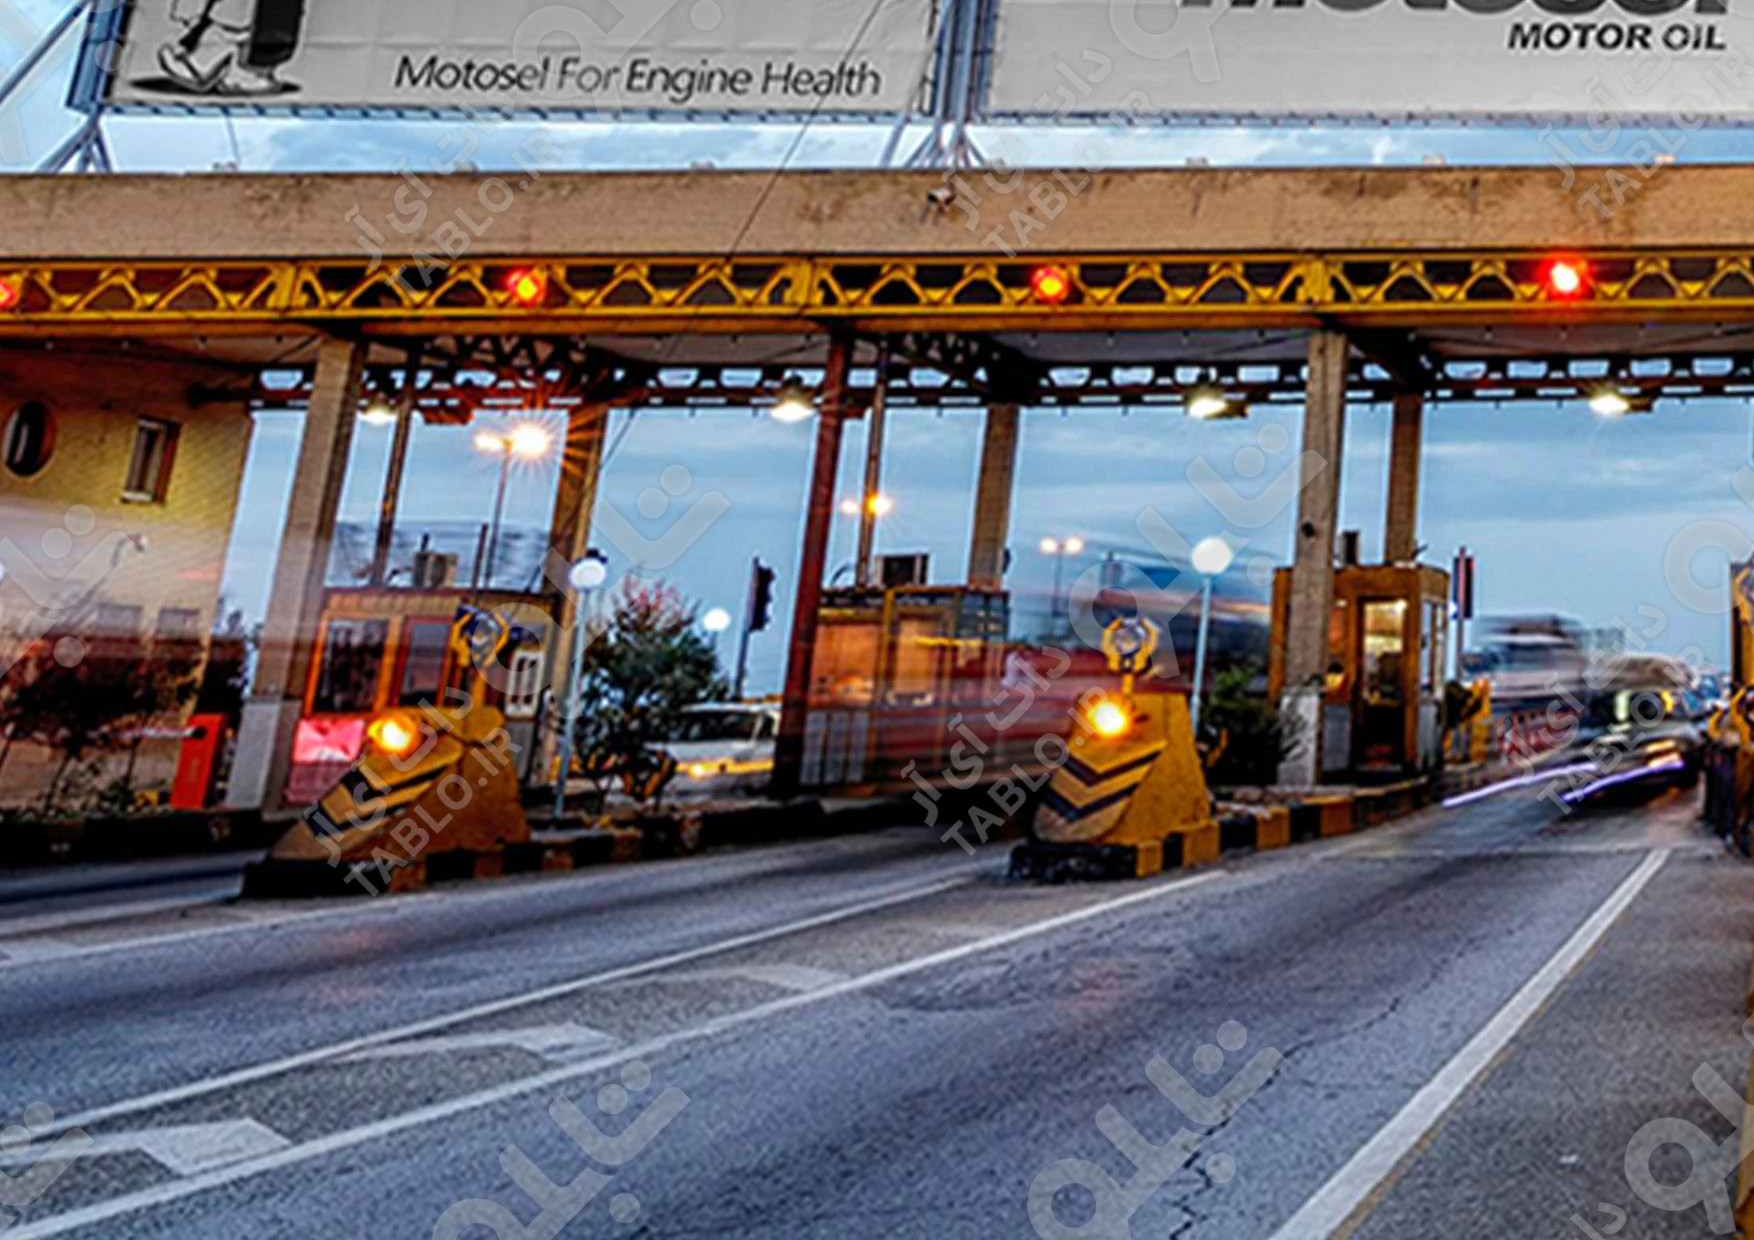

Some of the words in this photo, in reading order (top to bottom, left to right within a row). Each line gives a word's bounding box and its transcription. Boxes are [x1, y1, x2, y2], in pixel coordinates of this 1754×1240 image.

[1506, 23, 1652, 51] MOTOR
[1661, 23, 1728, 52] OIL
[394, 54, 549, 92] Motosel
[557, 56, 618, 92] For
[625, 57, 753, 105] Engine
[760, 61, 882, 97] Health
